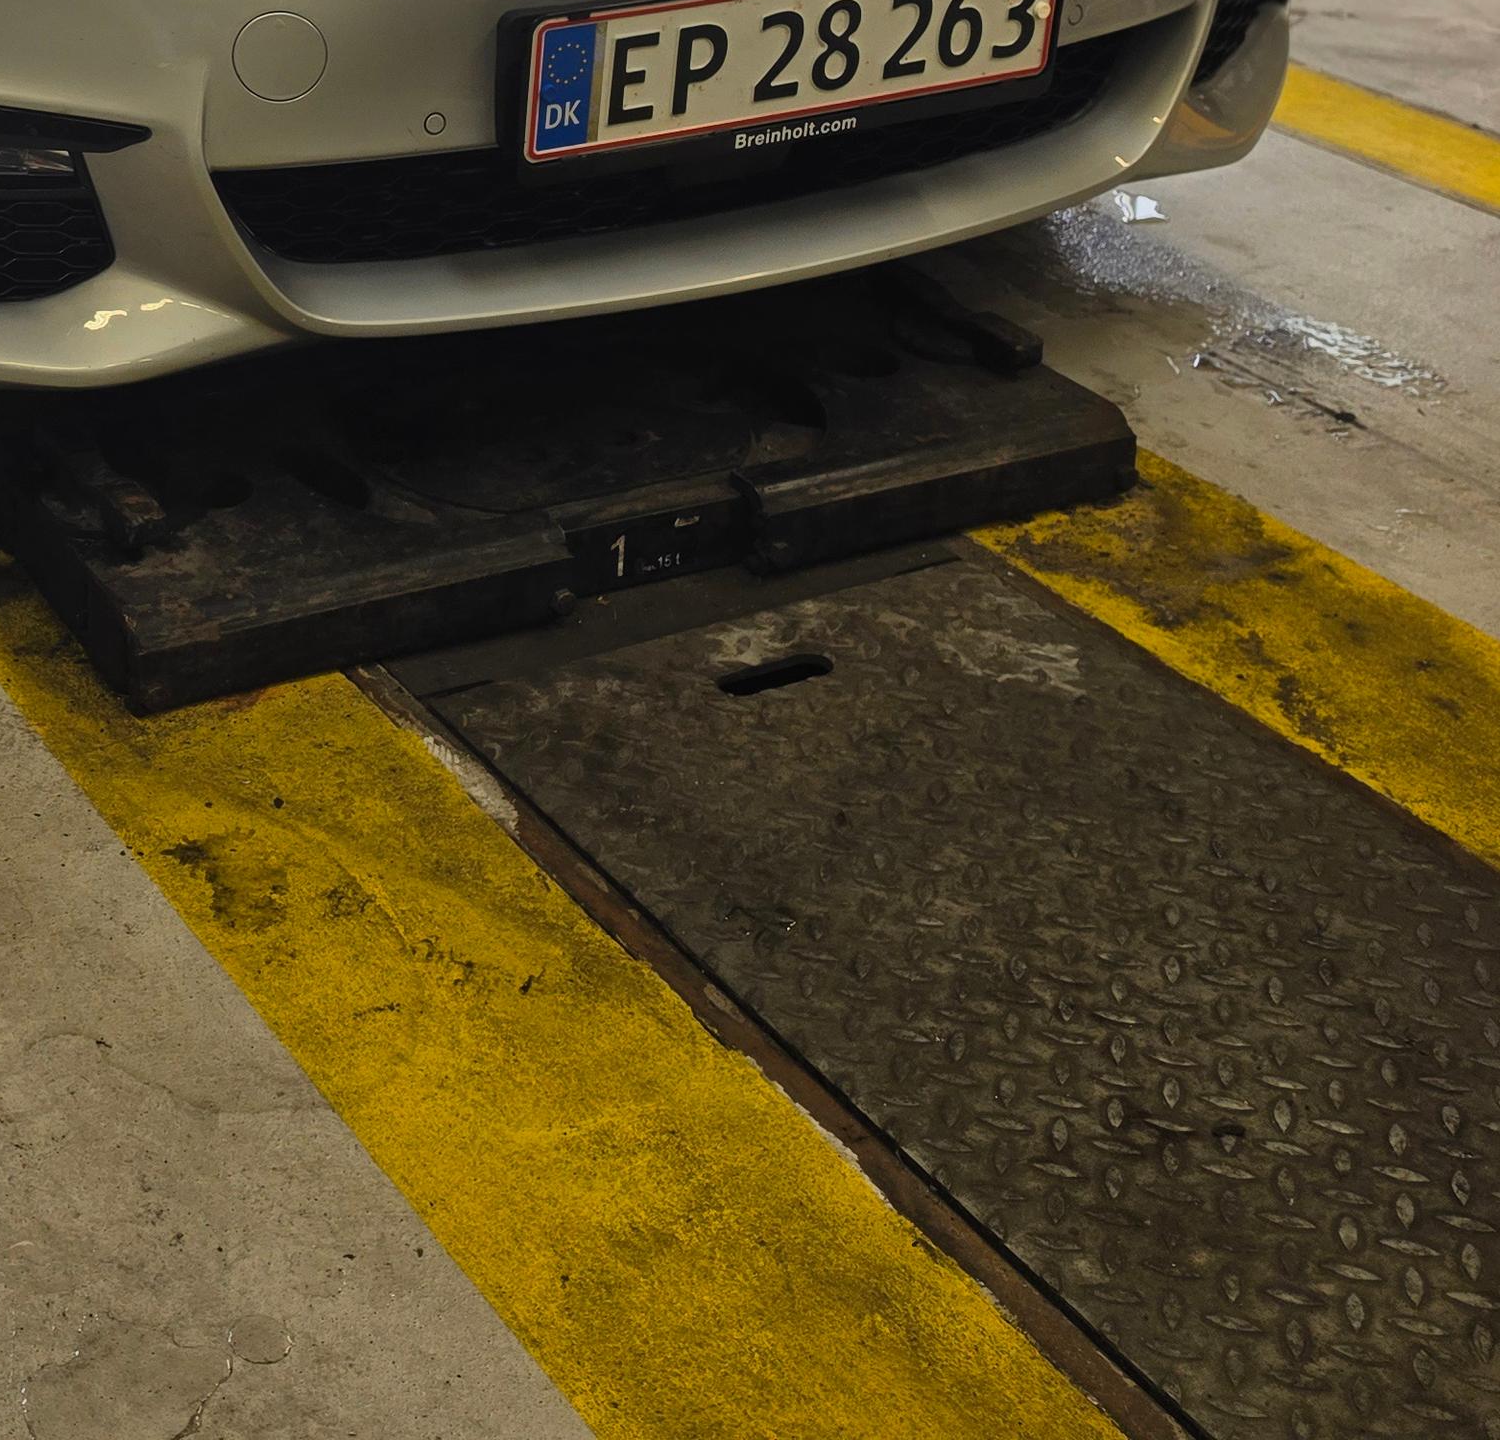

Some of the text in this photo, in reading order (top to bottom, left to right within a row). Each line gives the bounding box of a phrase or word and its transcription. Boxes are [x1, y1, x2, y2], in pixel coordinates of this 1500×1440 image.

[607, 23, 729, 126] EP
[544, 99, 581, 130] DK
[734, 116, 858, 150] Breinholt.com
[610, 534, 626, 577] 1
